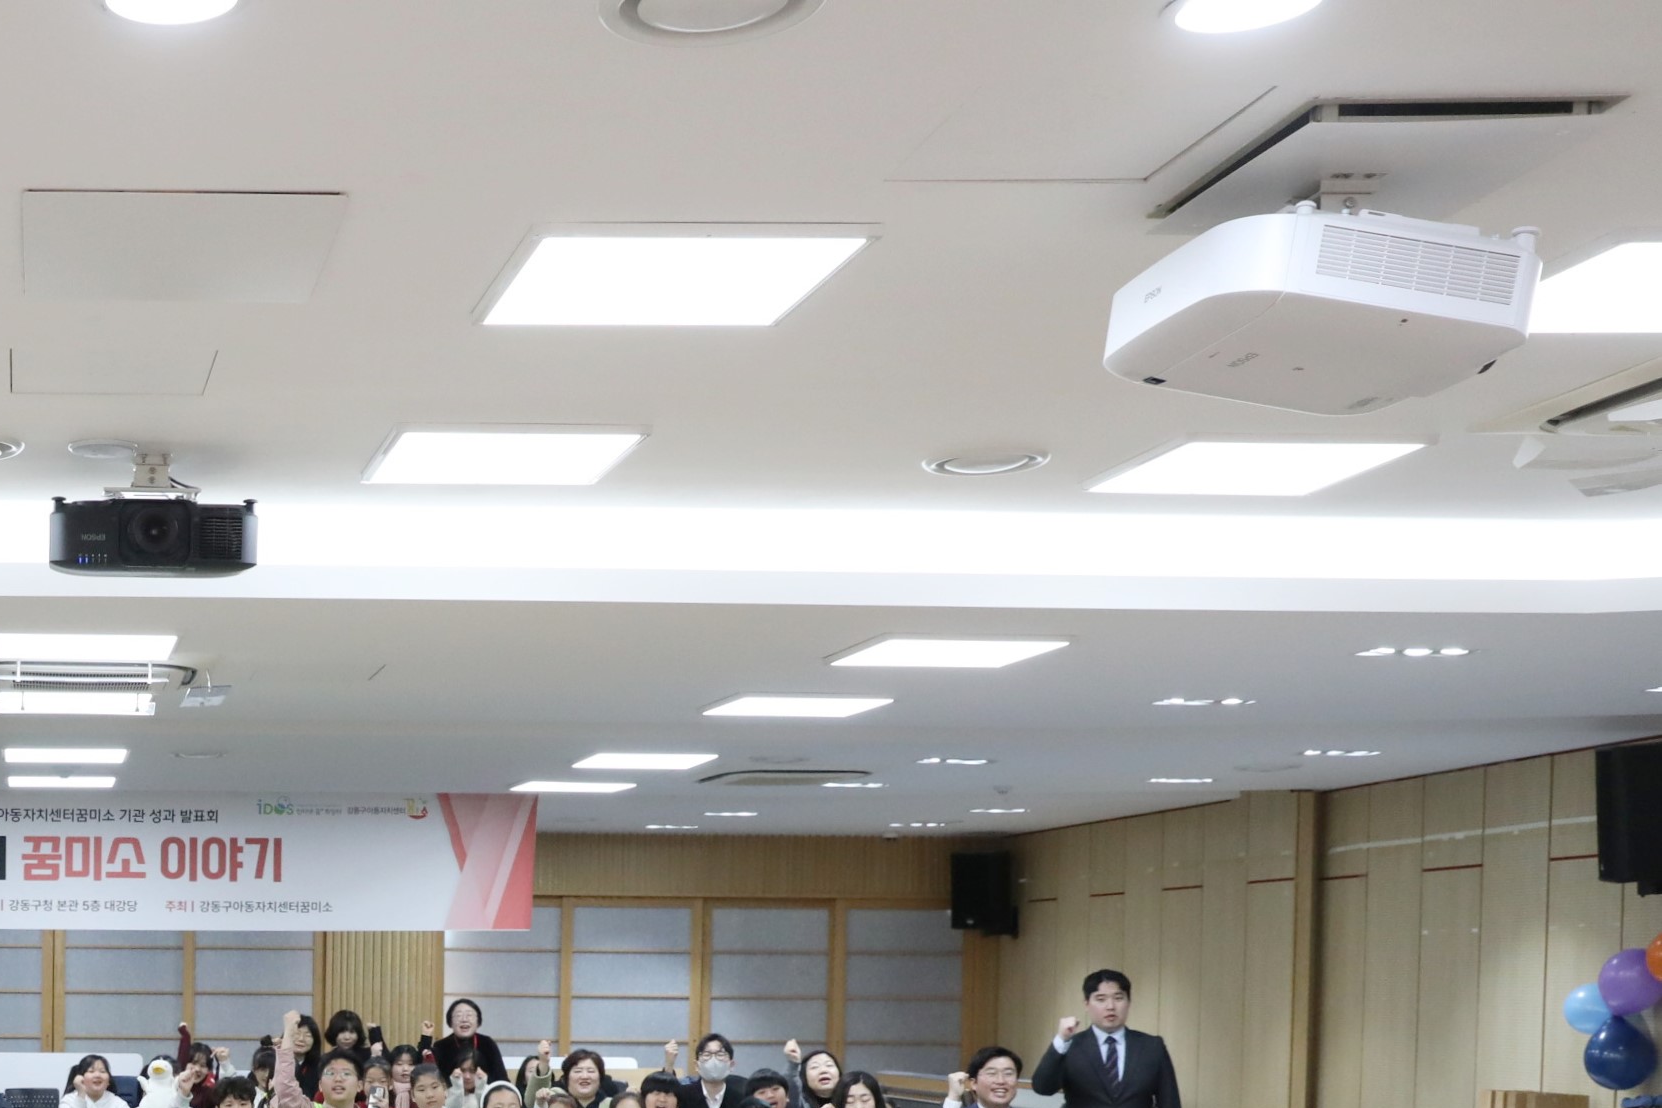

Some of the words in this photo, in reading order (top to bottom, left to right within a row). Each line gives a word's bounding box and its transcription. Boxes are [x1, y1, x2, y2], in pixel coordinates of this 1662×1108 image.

[81, 533, 106, 541] EPSON
[119, 808, 145, 823] 기관
[149, 809, 176, 824] 성과
[180, 809, 219, 824] 발표회
[22, 836, 146, 881] 꿈미소
[161, 837, 282, 882] 이야기
[9, 900, 53, 912] 강동구청
[57, 900, 78, 912] 본관
[82, 900, 101, 912] 5층
[104, 900, 138, 912] 대강당
[165, 901, 187, 913] 주최
[200, 901, 333, 913] 강동구아동자치센터꿈미소
